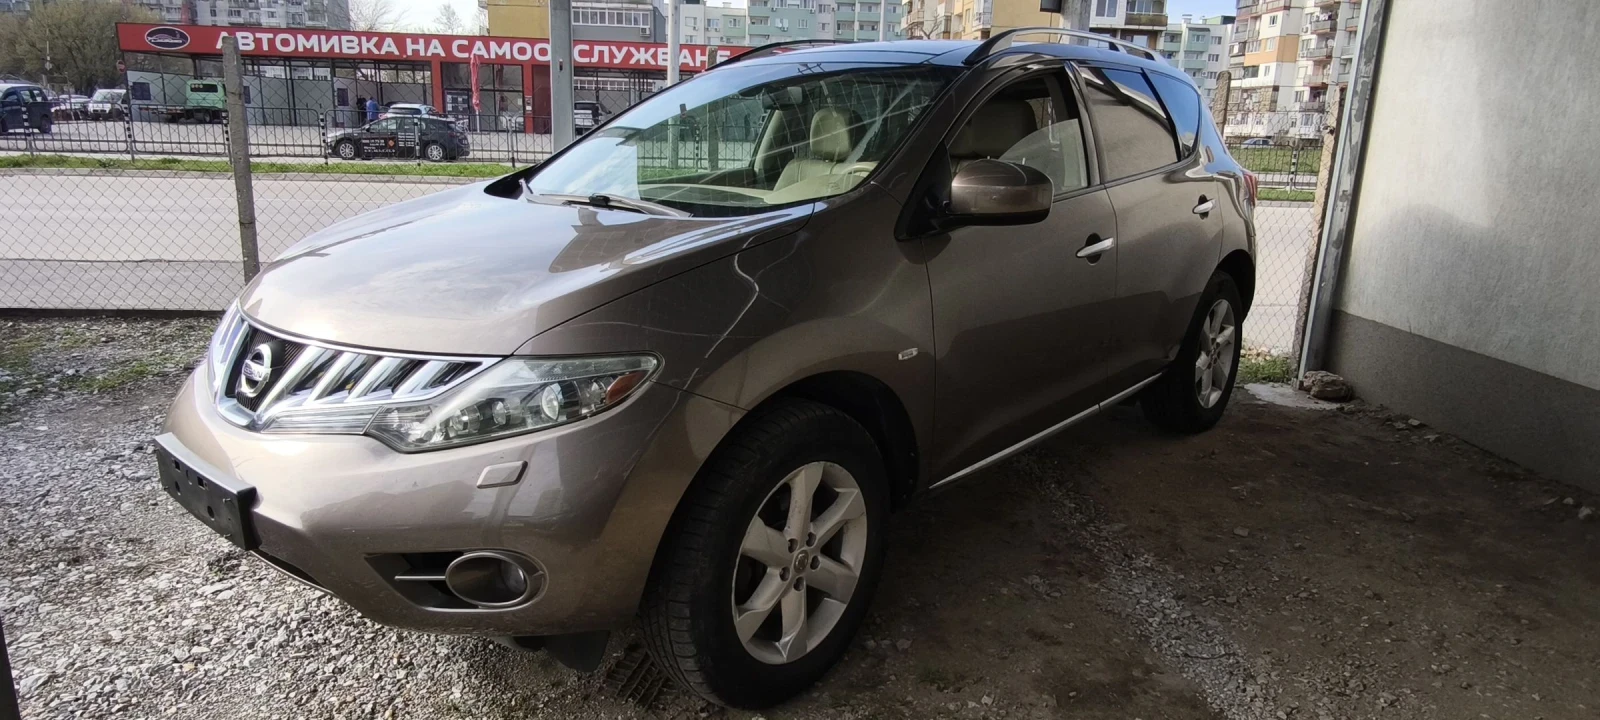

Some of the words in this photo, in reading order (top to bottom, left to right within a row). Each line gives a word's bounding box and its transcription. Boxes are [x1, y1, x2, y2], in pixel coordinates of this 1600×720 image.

[216, 31, 399, 55] АВТОМИВКА
[406, 38, 446, 57] НА
[452, 40, 731, 67] САМООСЛУЖВАНЕ
